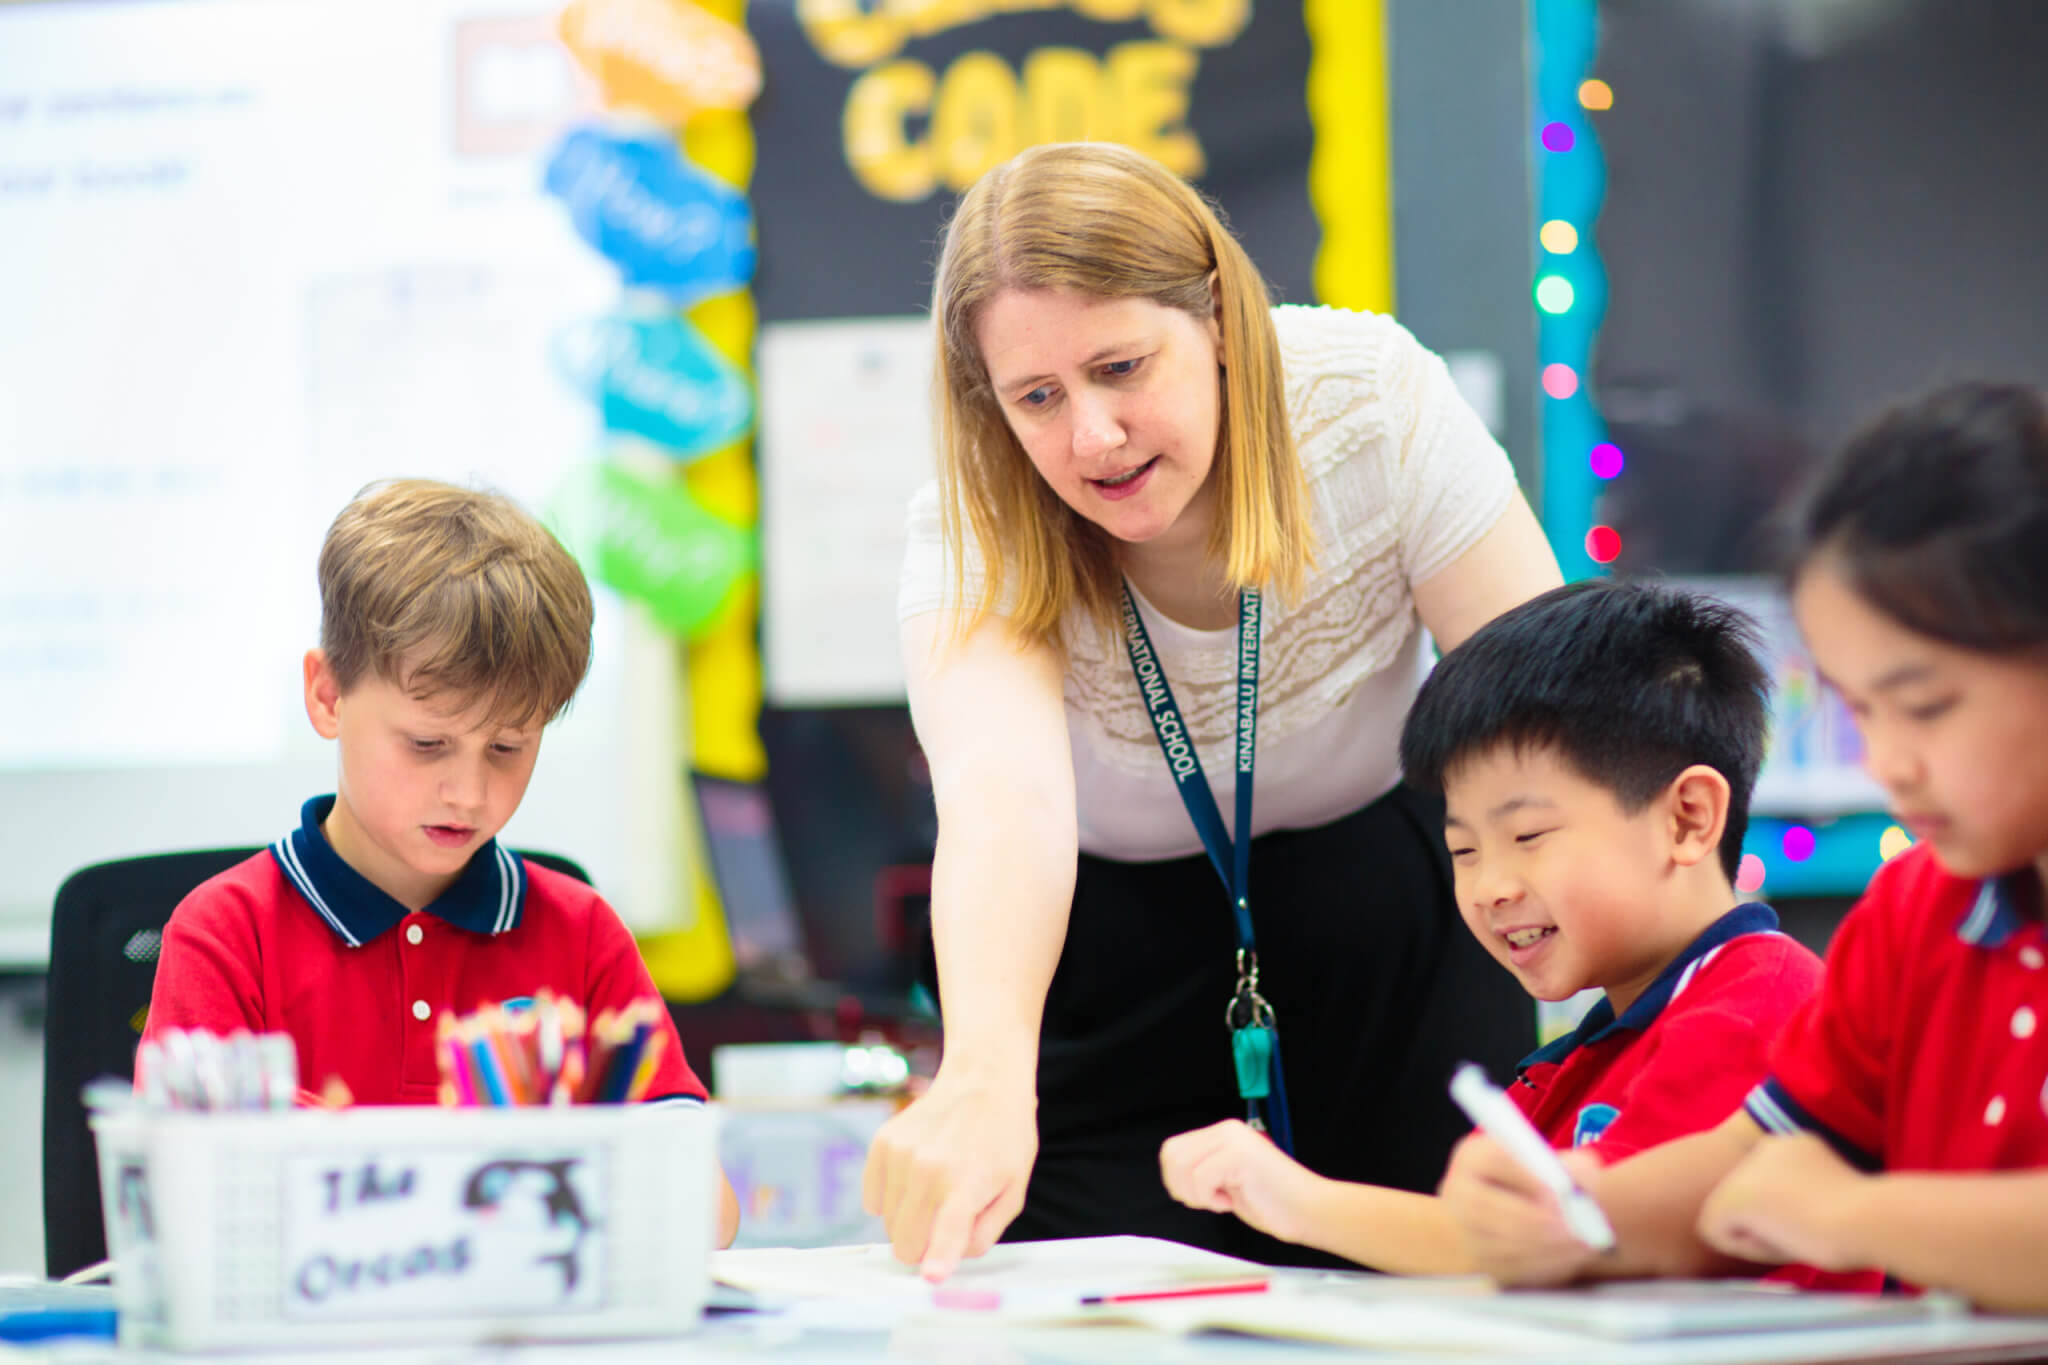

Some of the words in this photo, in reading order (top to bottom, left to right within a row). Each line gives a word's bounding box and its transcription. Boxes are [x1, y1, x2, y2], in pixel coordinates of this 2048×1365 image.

[843, 38, 1207, 203] CODE
[1154, 709, 1198, 783] SCHOOL
[1239, 683, 1256, 773] KINABALU
[320, 1161, 418, 1215] The
[294, 1236, 475, 1303] Orcas
